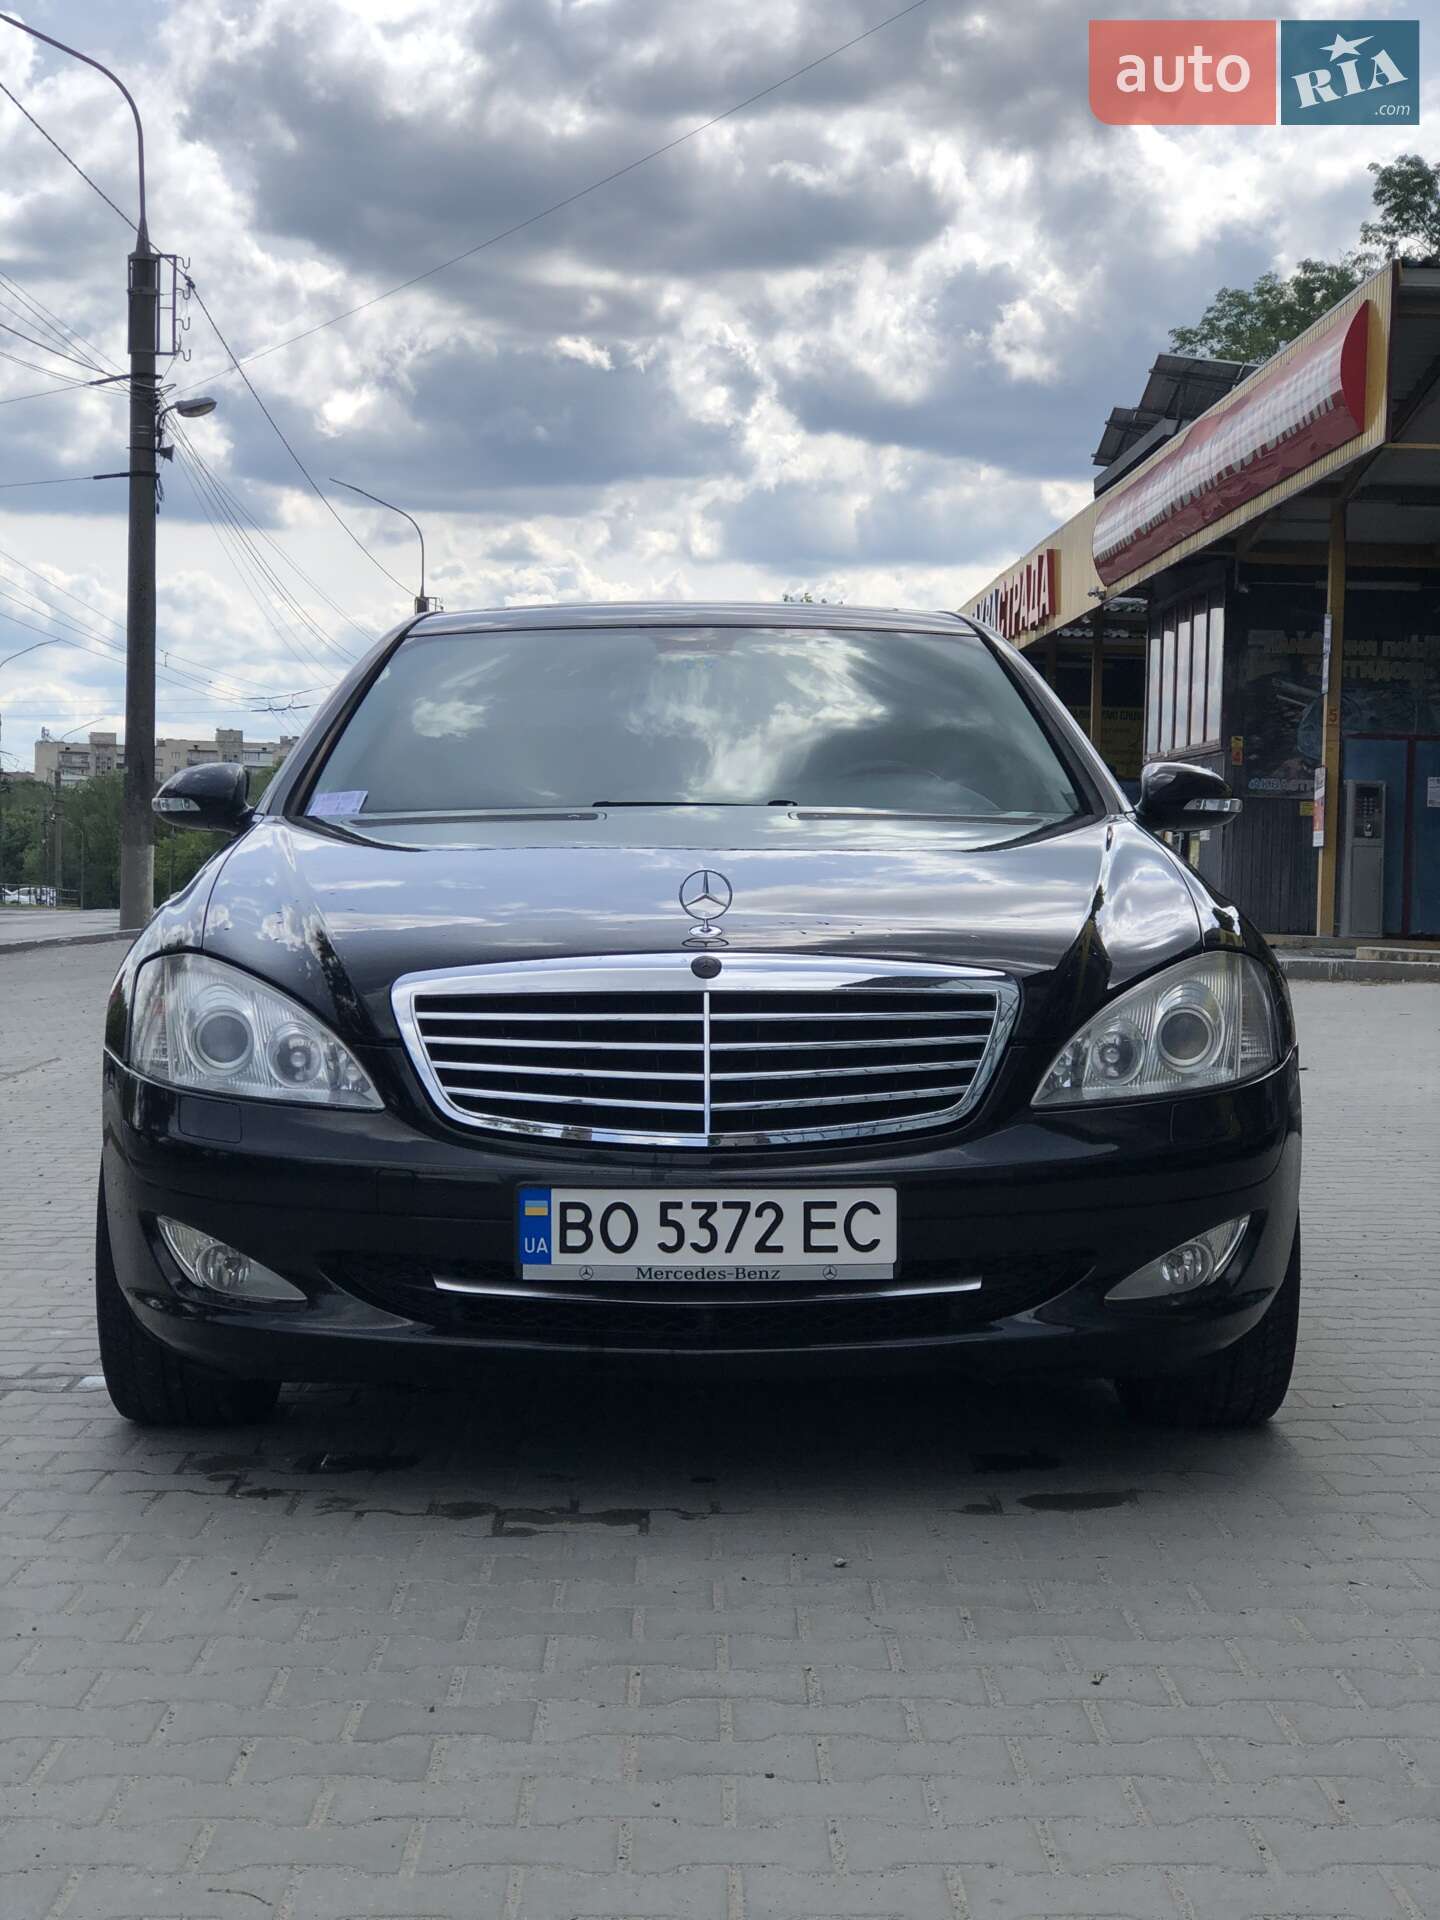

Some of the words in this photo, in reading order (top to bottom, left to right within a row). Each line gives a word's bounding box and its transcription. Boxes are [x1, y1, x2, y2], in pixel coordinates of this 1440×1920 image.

[559, 1201, 639, 1255] BO
[657, 1201, 784, 1254] 5372
[803, 1201, 881, 1253] EC
[524, 1237, 549, 1253] UA
[635, 1266, 781, 1281] Mercedes-Benz
